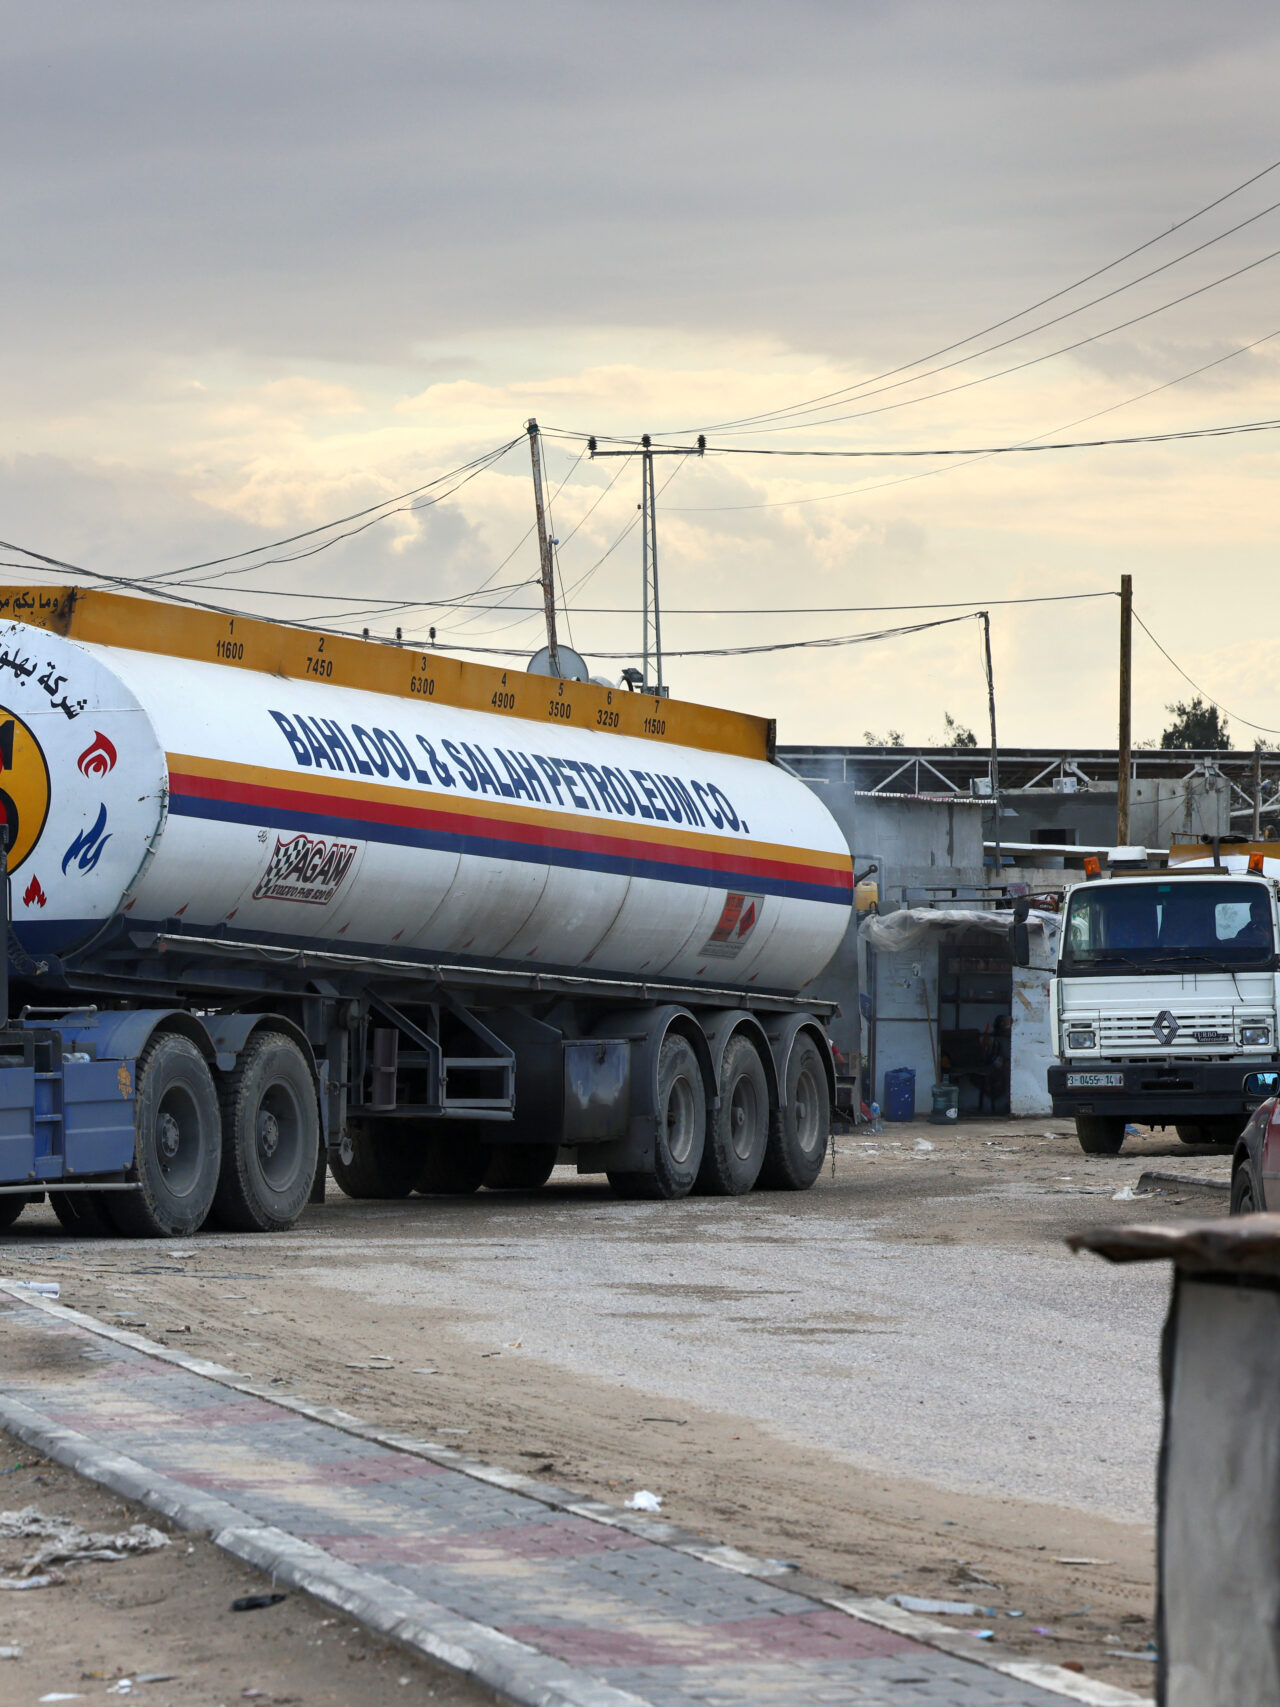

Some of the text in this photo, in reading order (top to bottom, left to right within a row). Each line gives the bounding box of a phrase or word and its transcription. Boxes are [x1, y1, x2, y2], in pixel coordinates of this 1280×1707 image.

[228, 619, 234, 635] 1
[216, 639, 244, 661] 11600
[318, 637, 325, 653] 2
[306, 657, 333, 677] 7450
[421, 656, 427, 671] 3
[410, 676, 435, 695] 6300
[501, 672, 507, 687] 4
[37, 661, 87, 720] شركة
[558, 683, 564, 697] 5
[607, 691, 612, 705] 6
[491, 692, 515, 710] 4900
[548, 701, 571, 719] 3500
[655, 700, 660, 713] 7
[597, 709, 619, 728] 3250
[643, 718, 666, 735] 11500
[268, 709, 750, 834] BAHLOOL & SALAH PETROLEUM CO.
[282, 847, 353, 886] AGAM
